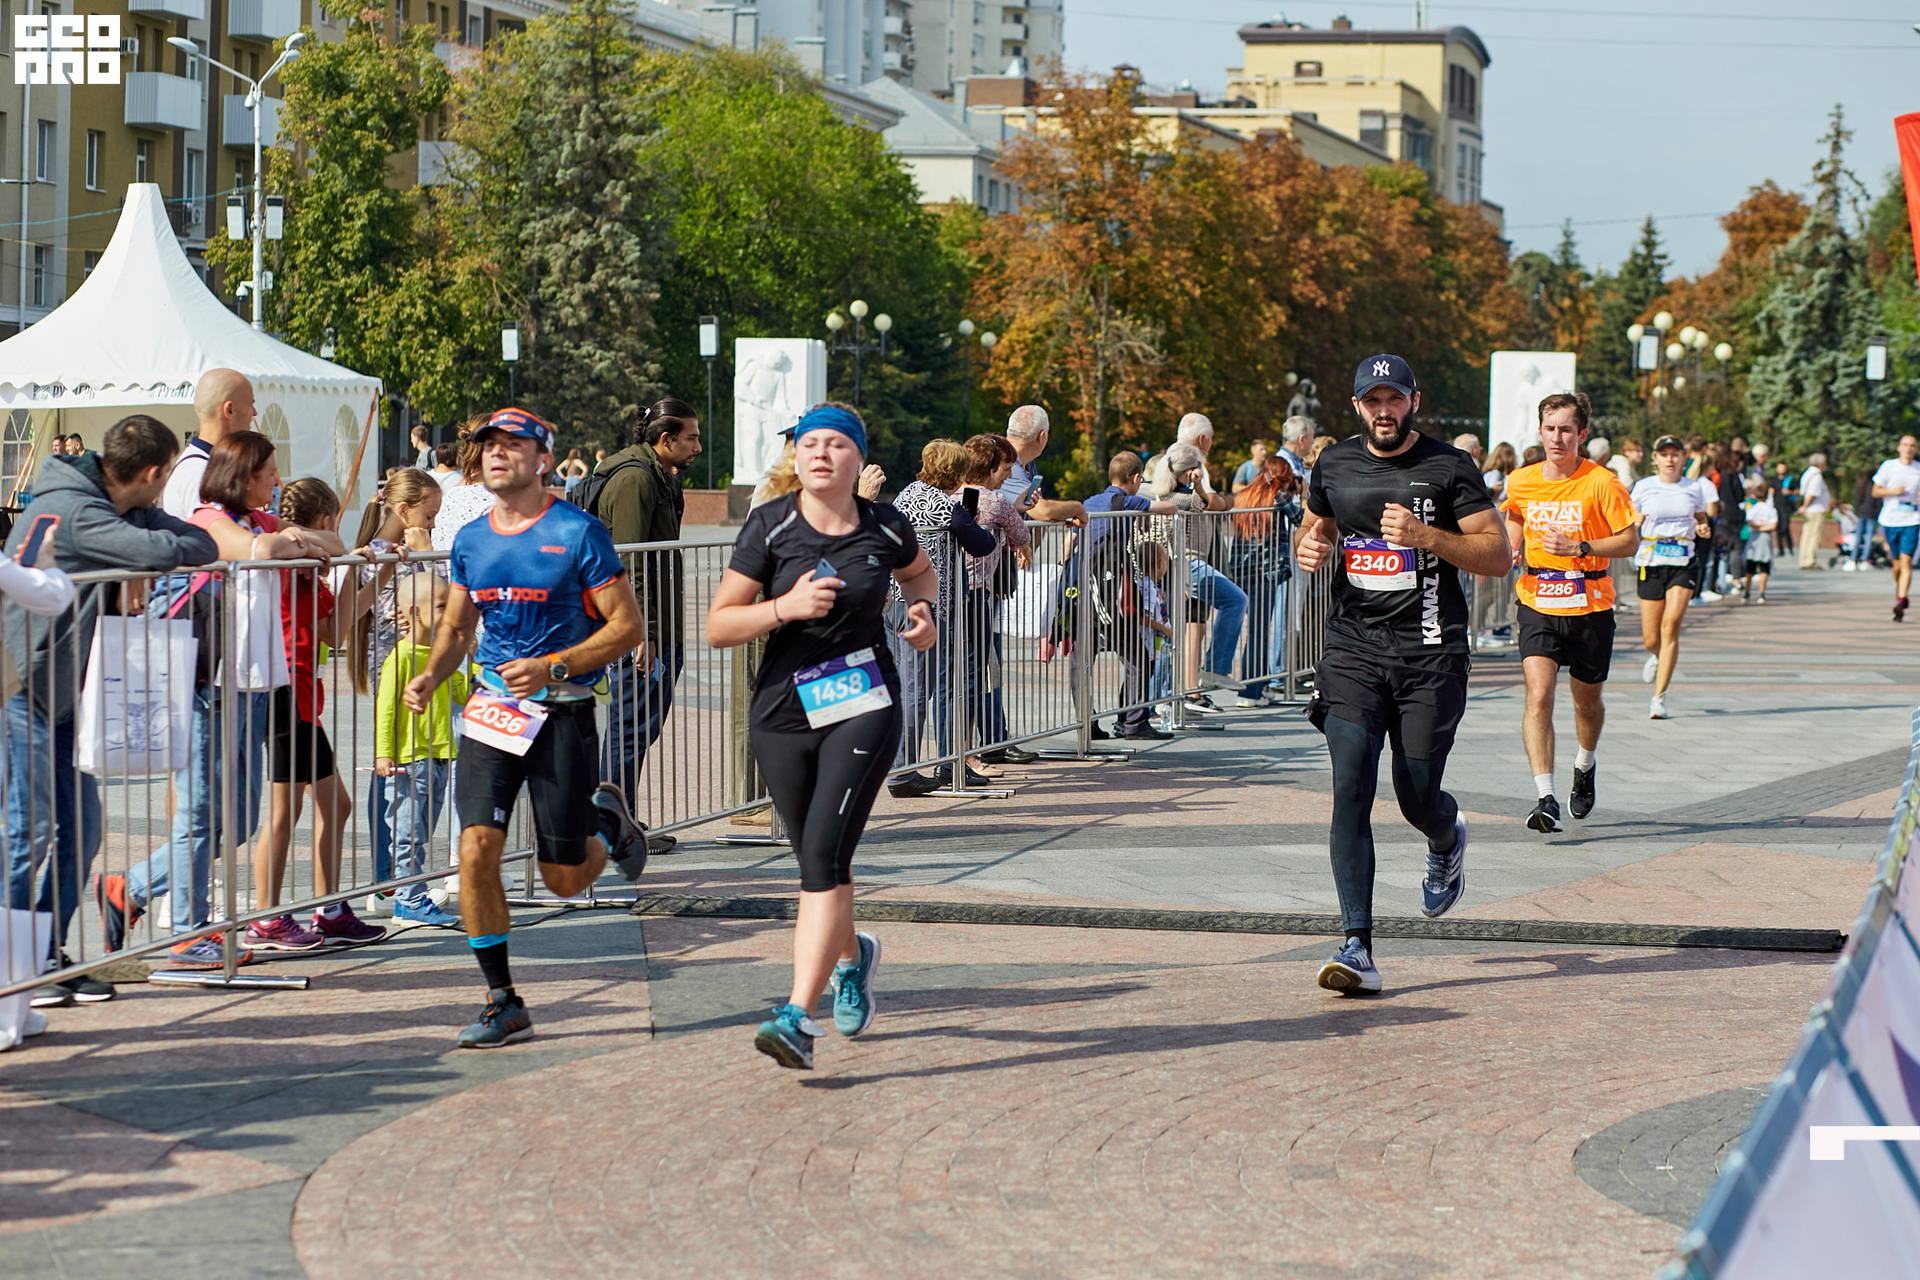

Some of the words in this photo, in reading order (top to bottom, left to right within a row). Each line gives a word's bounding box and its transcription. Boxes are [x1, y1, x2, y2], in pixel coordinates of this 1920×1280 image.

[1373, 360, 1390, 376] NY
[1527, 506, 1582, 525] KAZAN
[1528, 523, 1582, 532] MARTHON
[1659, 546, 1682, 557] 1366
[1350, 554, 1399, 572] 2340
[1538, 582, 1573, 595] 2286
[1421, 573, 1442, 645] KAMAZ
[811, 672, 863, 706] 1458
[468, 702, 525, 733] 2036
